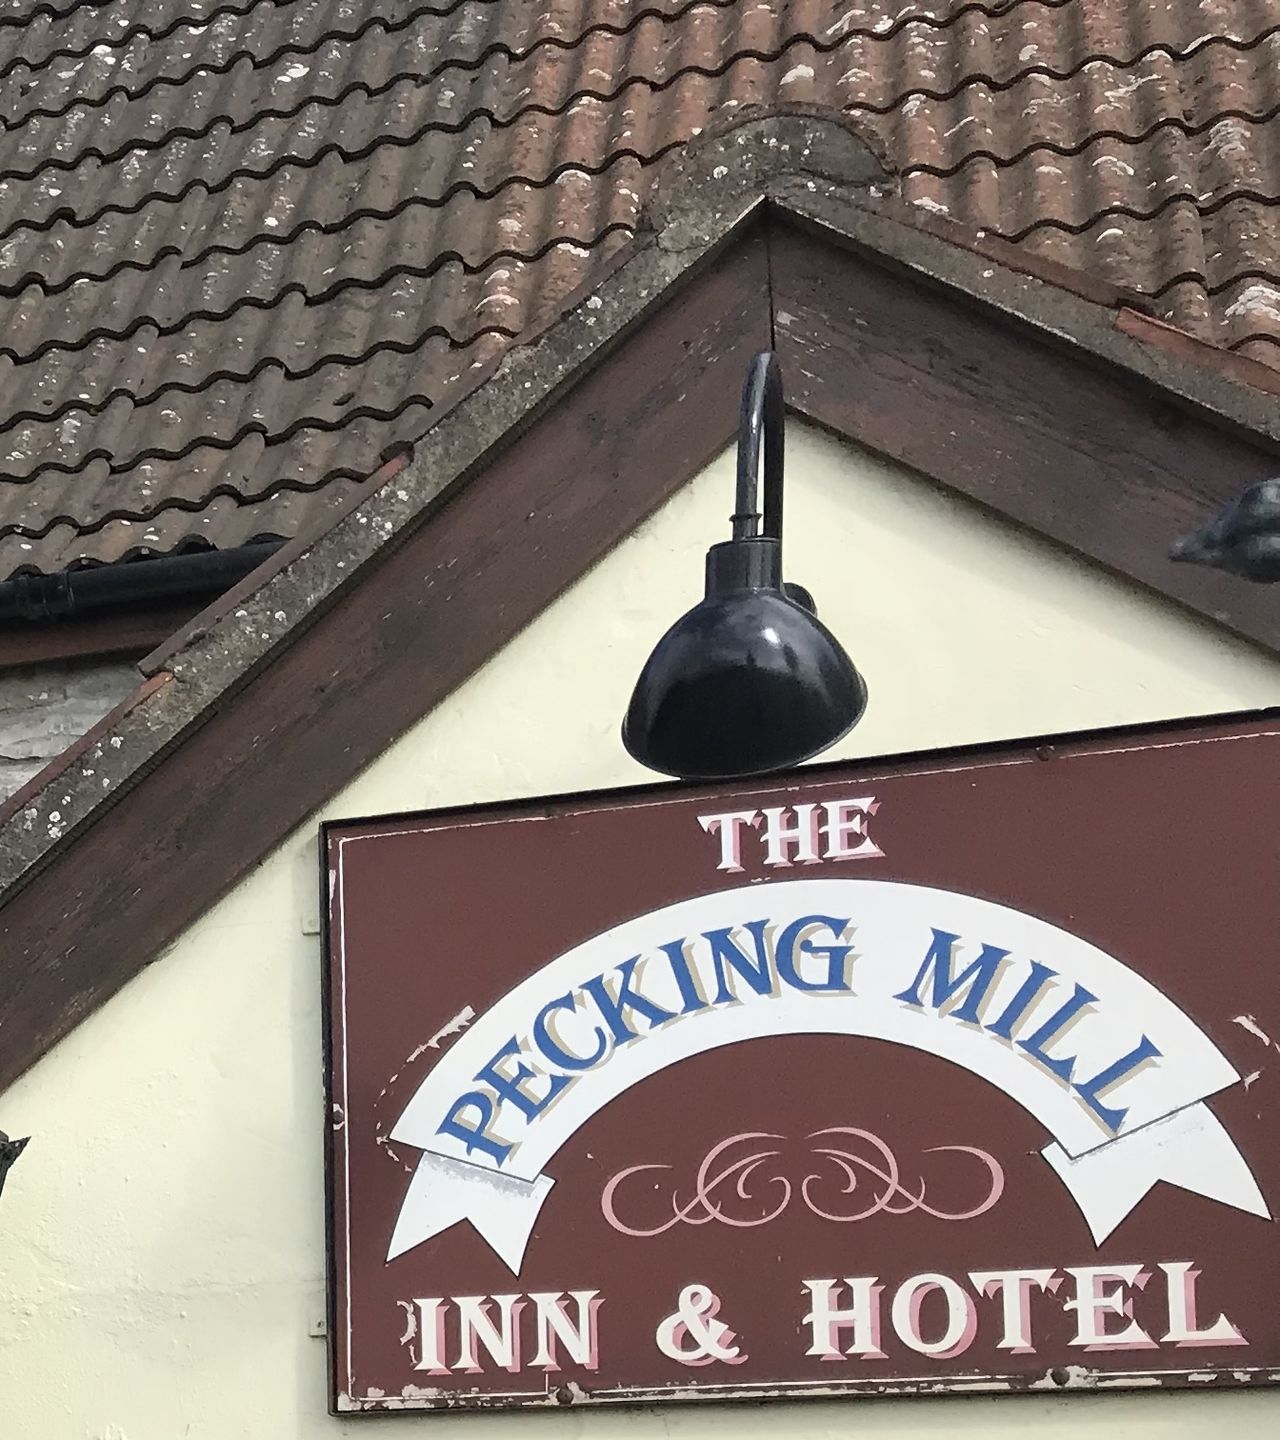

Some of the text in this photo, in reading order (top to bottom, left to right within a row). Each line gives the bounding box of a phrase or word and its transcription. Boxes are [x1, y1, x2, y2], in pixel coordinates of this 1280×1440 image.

[697, 796, 887, 873] THE
[434, 913, 1166, 1170] PECKING MILL
[411, 1261, 1250, 1375] INN & HOTEL
